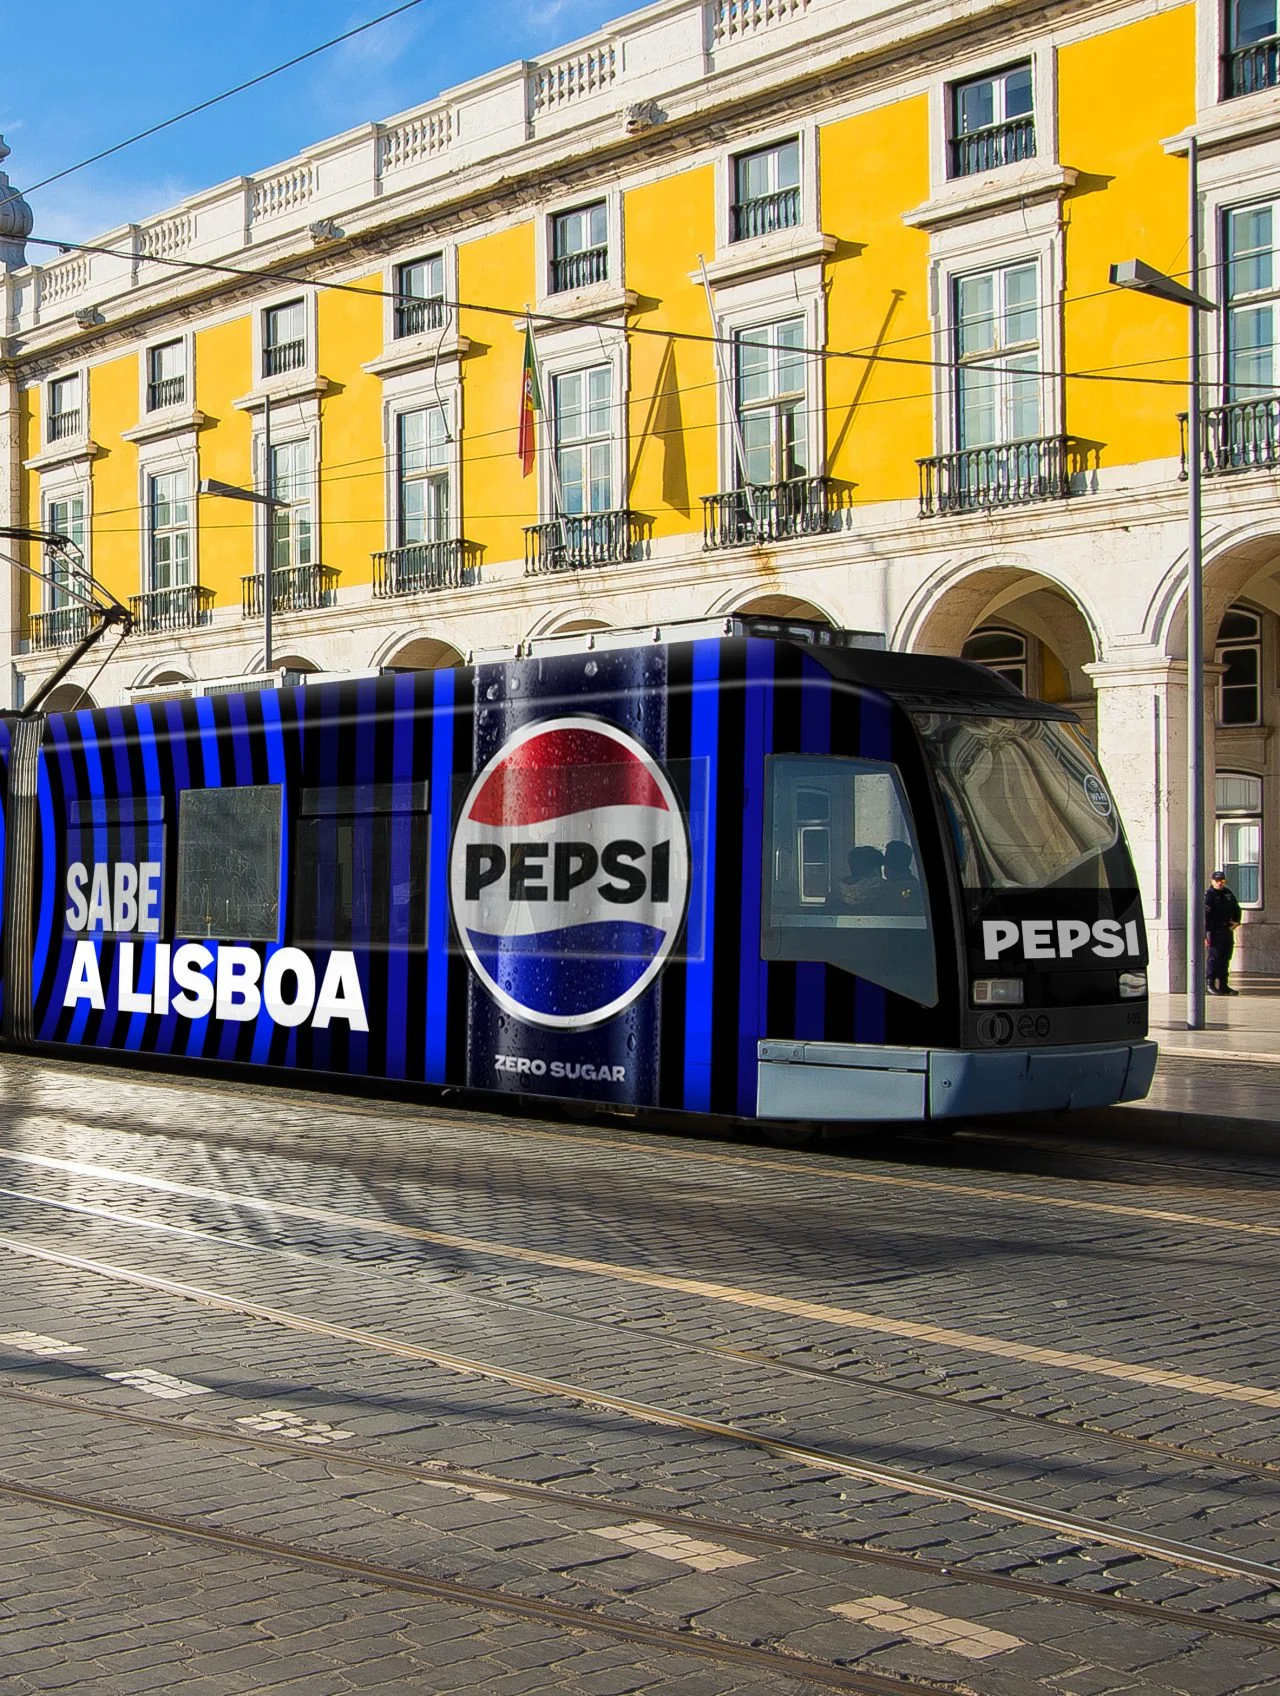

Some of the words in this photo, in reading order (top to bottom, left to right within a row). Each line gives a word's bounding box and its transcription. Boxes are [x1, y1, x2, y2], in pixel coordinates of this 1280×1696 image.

[66, 862, 160, 933] SABE
[466, 840, 670, 905] PEPSI
[982, 919, 1140, 961] PEPSI
[63, 940, 106, 1010] A
[117, 942, 370, 1032] LISBOA
[494, 1054, 547, 1076] ZERO
[549, 1061, 626, 1082] SUGAR
